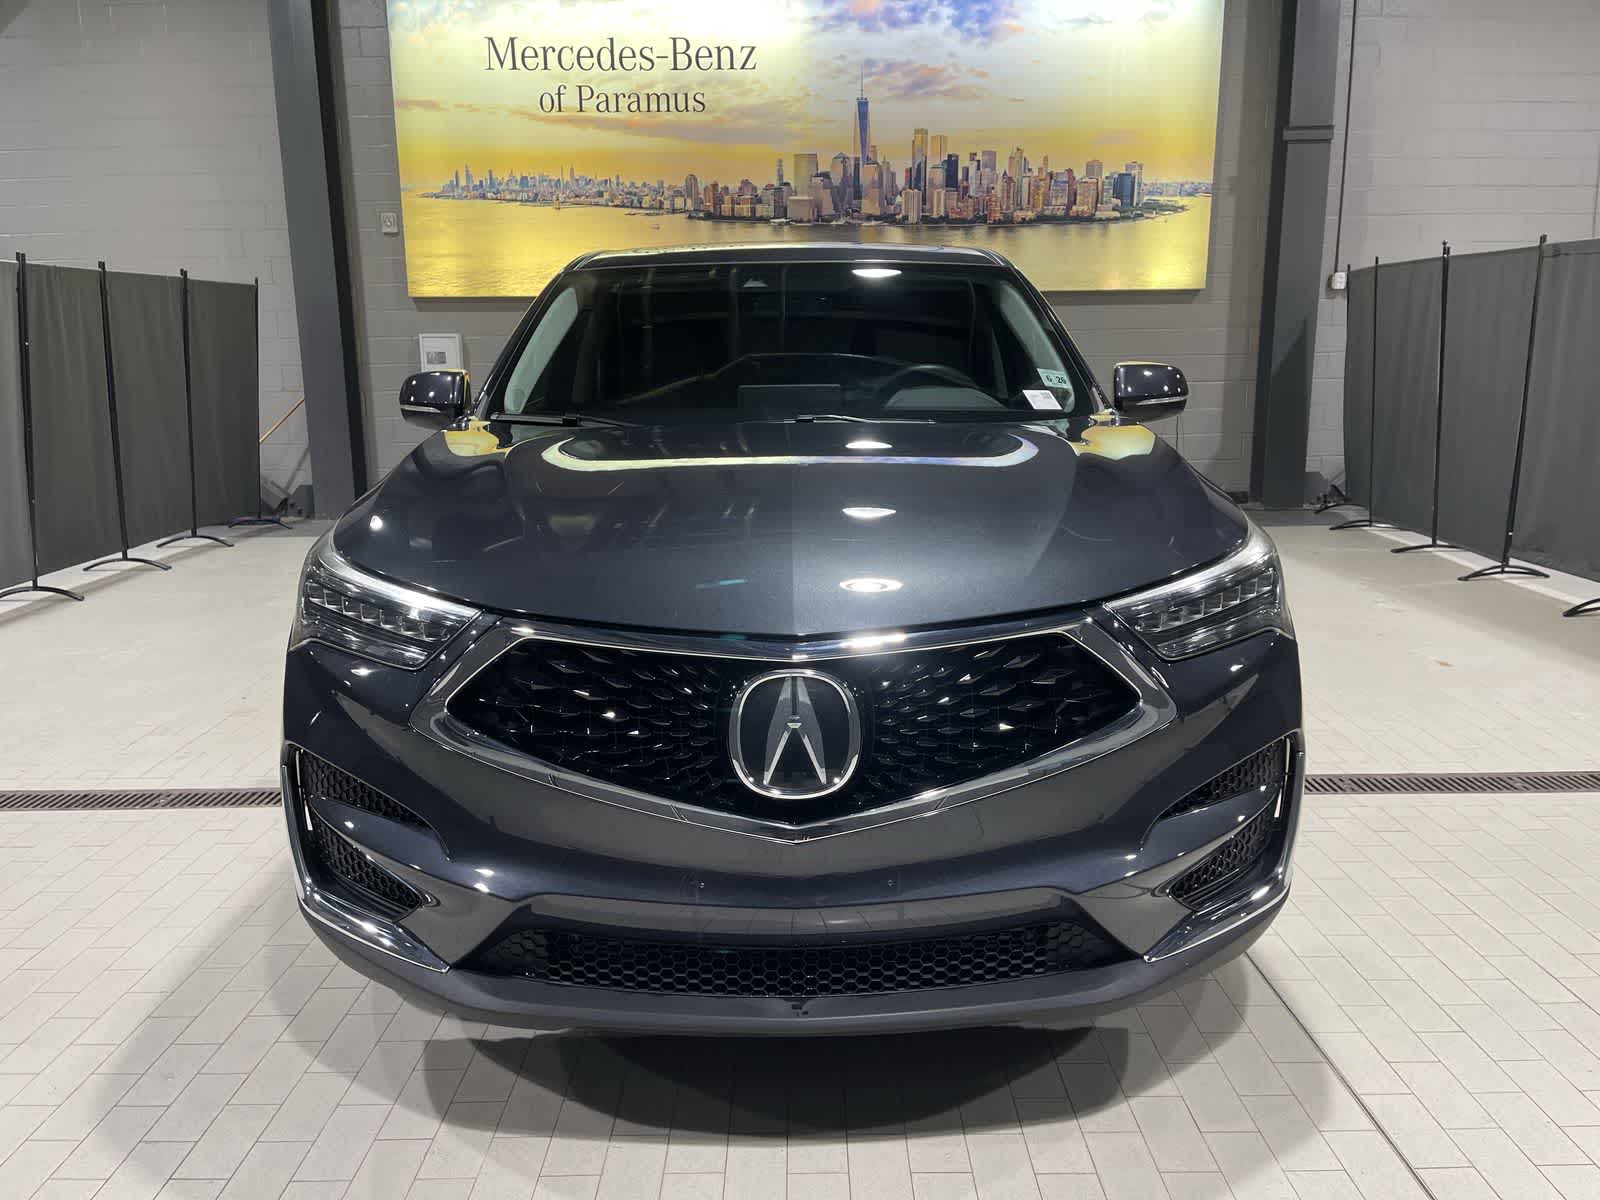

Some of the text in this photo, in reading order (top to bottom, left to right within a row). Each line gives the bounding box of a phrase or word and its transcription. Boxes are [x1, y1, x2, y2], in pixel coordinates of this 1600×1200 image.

[484, 36, 757, 71] Mercedes-Benz
[539, 84, 706, 113] of Paramus
